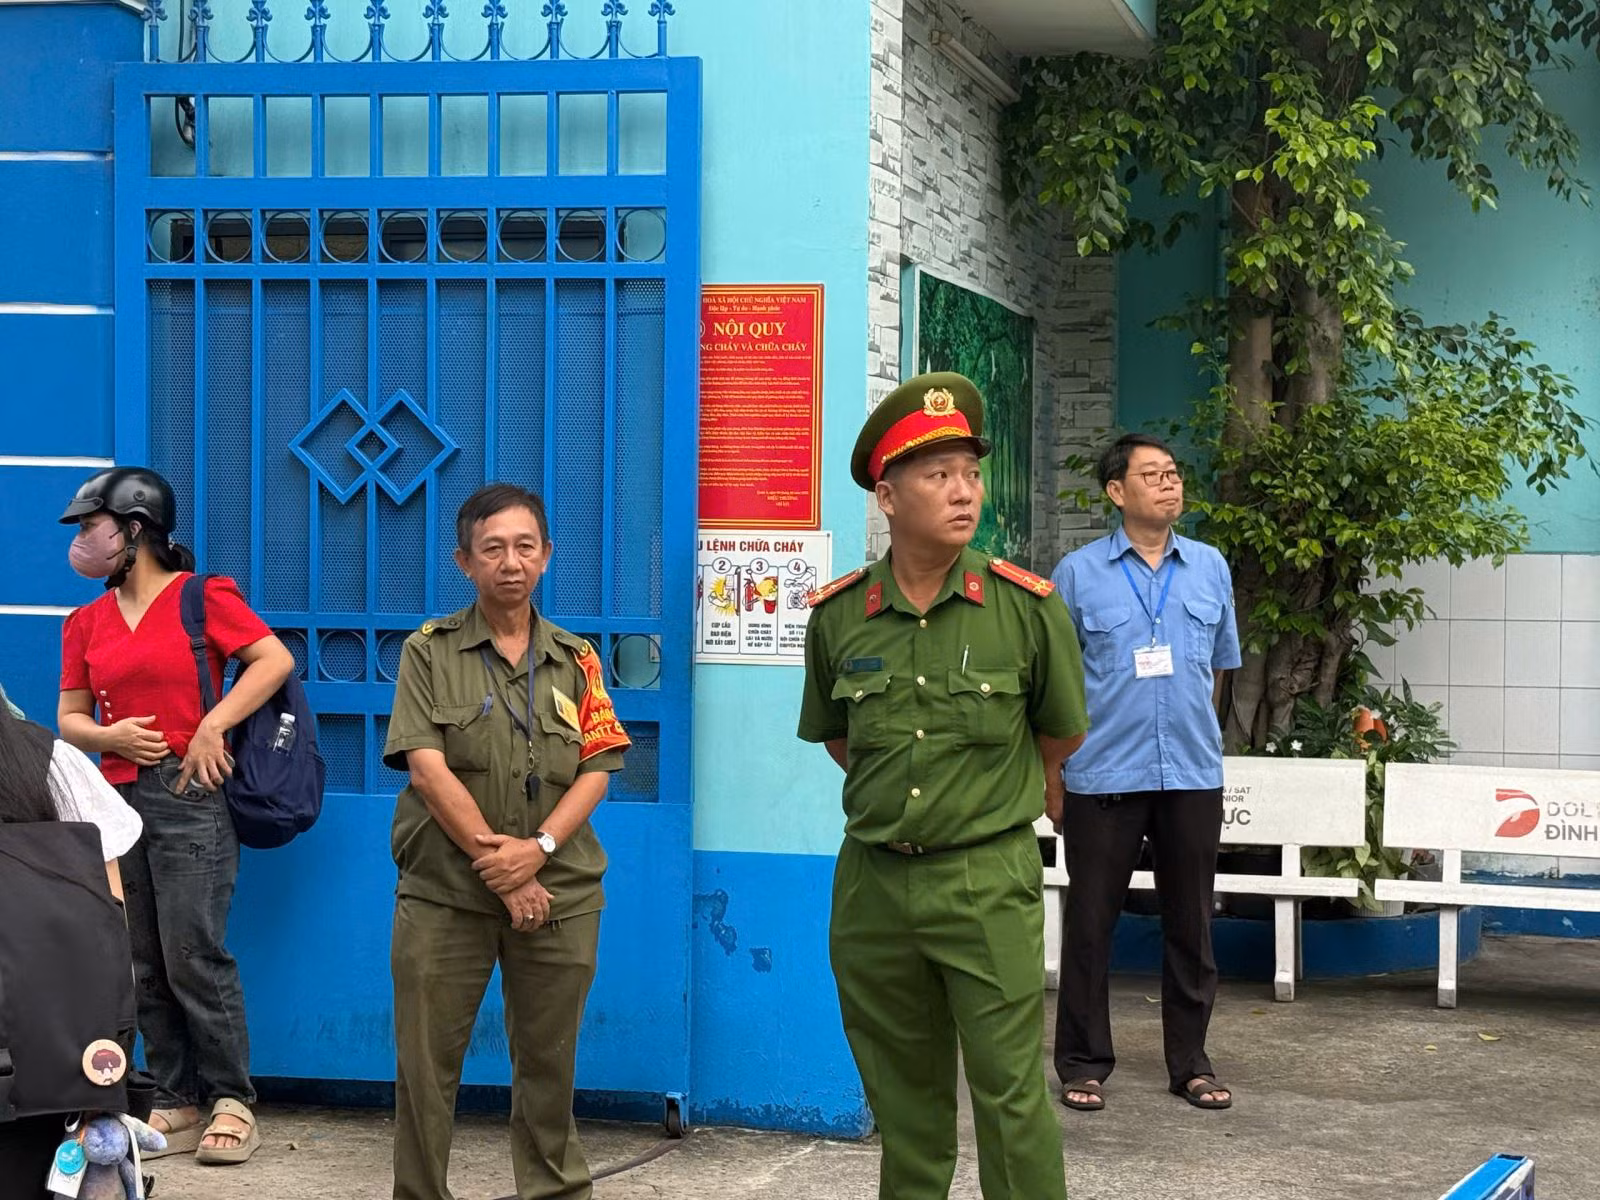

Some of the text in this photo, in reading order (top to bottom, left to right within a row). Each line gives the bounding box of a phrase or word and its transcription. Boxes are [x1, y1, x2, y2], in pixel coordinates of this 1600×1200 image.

[713, 318, 787, 340] NỘI QUY
[714, 341, 740, 351] CHÁY
[741, 341, 753, 351] VÀ
[754, 341, 780, 351] CHỮA
[782, 341, 807, 351] CHÁY
[707, 538, 736, 554] LỆNH
[739, 538, 770, 552] CHỮA
[773, 540, 804, 553] CHÁY
[718, 561, 726, 571] 2
[757, 561, 764, 571] 3
[793, 562, 801, 572] 4
[584, 724, 612, 744] ANTT
[1234, 786, 1252, 794] SAT
[1222, 795, 1244, 803] NIOR
[1547, 802, 1593, 818] DOL
[1222, 807, 1251, 830] ỰC
[1544, 818, 1598, 842] ĐÌNH
